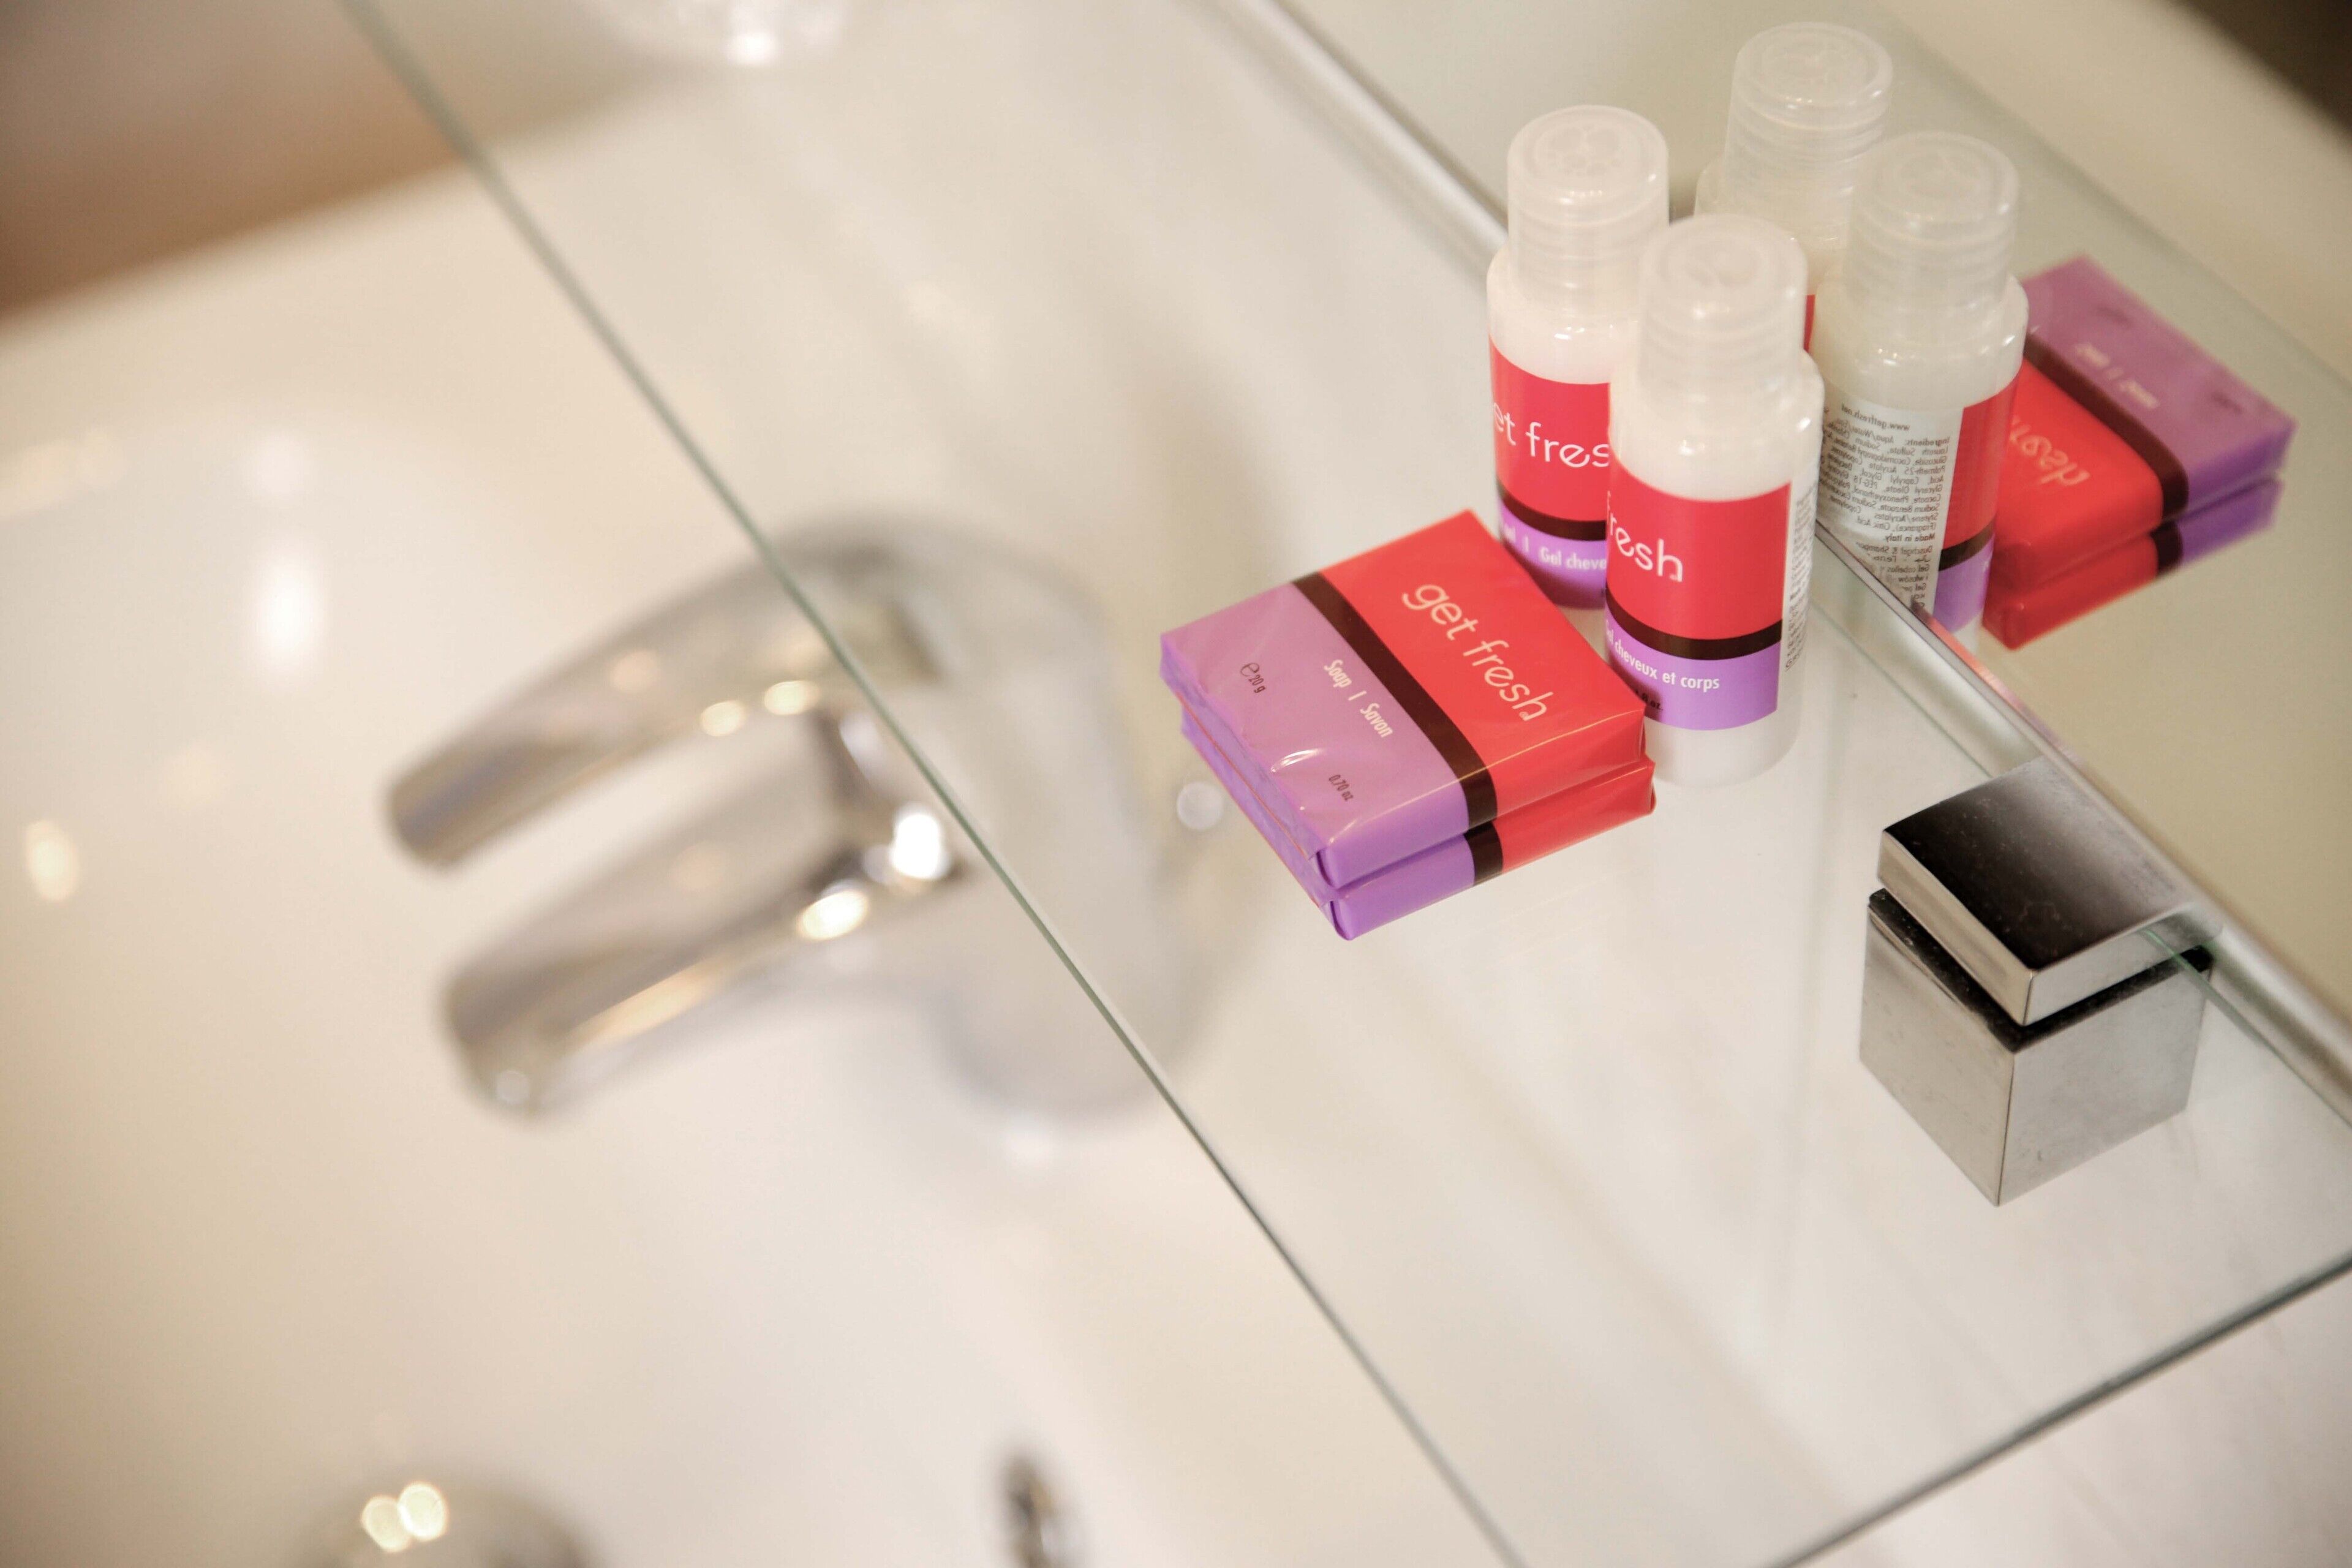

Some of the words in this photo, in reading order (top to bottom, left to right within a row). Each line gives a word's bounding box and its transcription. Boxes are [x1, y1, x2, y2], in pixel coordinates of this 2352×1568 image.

[1493, 402, 1516, 445] et
[1525, 421, 1609, 468] fres
[1540, 546, 1562, 566] Gel
[1566, 552, 1607, 570] cheve
[1607, 494, 1683, 582] resh
[1401, 584, 1479, 641] get
[1463, 639, 1555, 722] fresh
[1615, 639, 1657, 680] cheveux
[1662, 672, 1676, 685] et
[1680, 674, 1721, 693] corps
[1324, 659, 1352, 688] Soap
[1360, 703, 1393, 738] Savon
